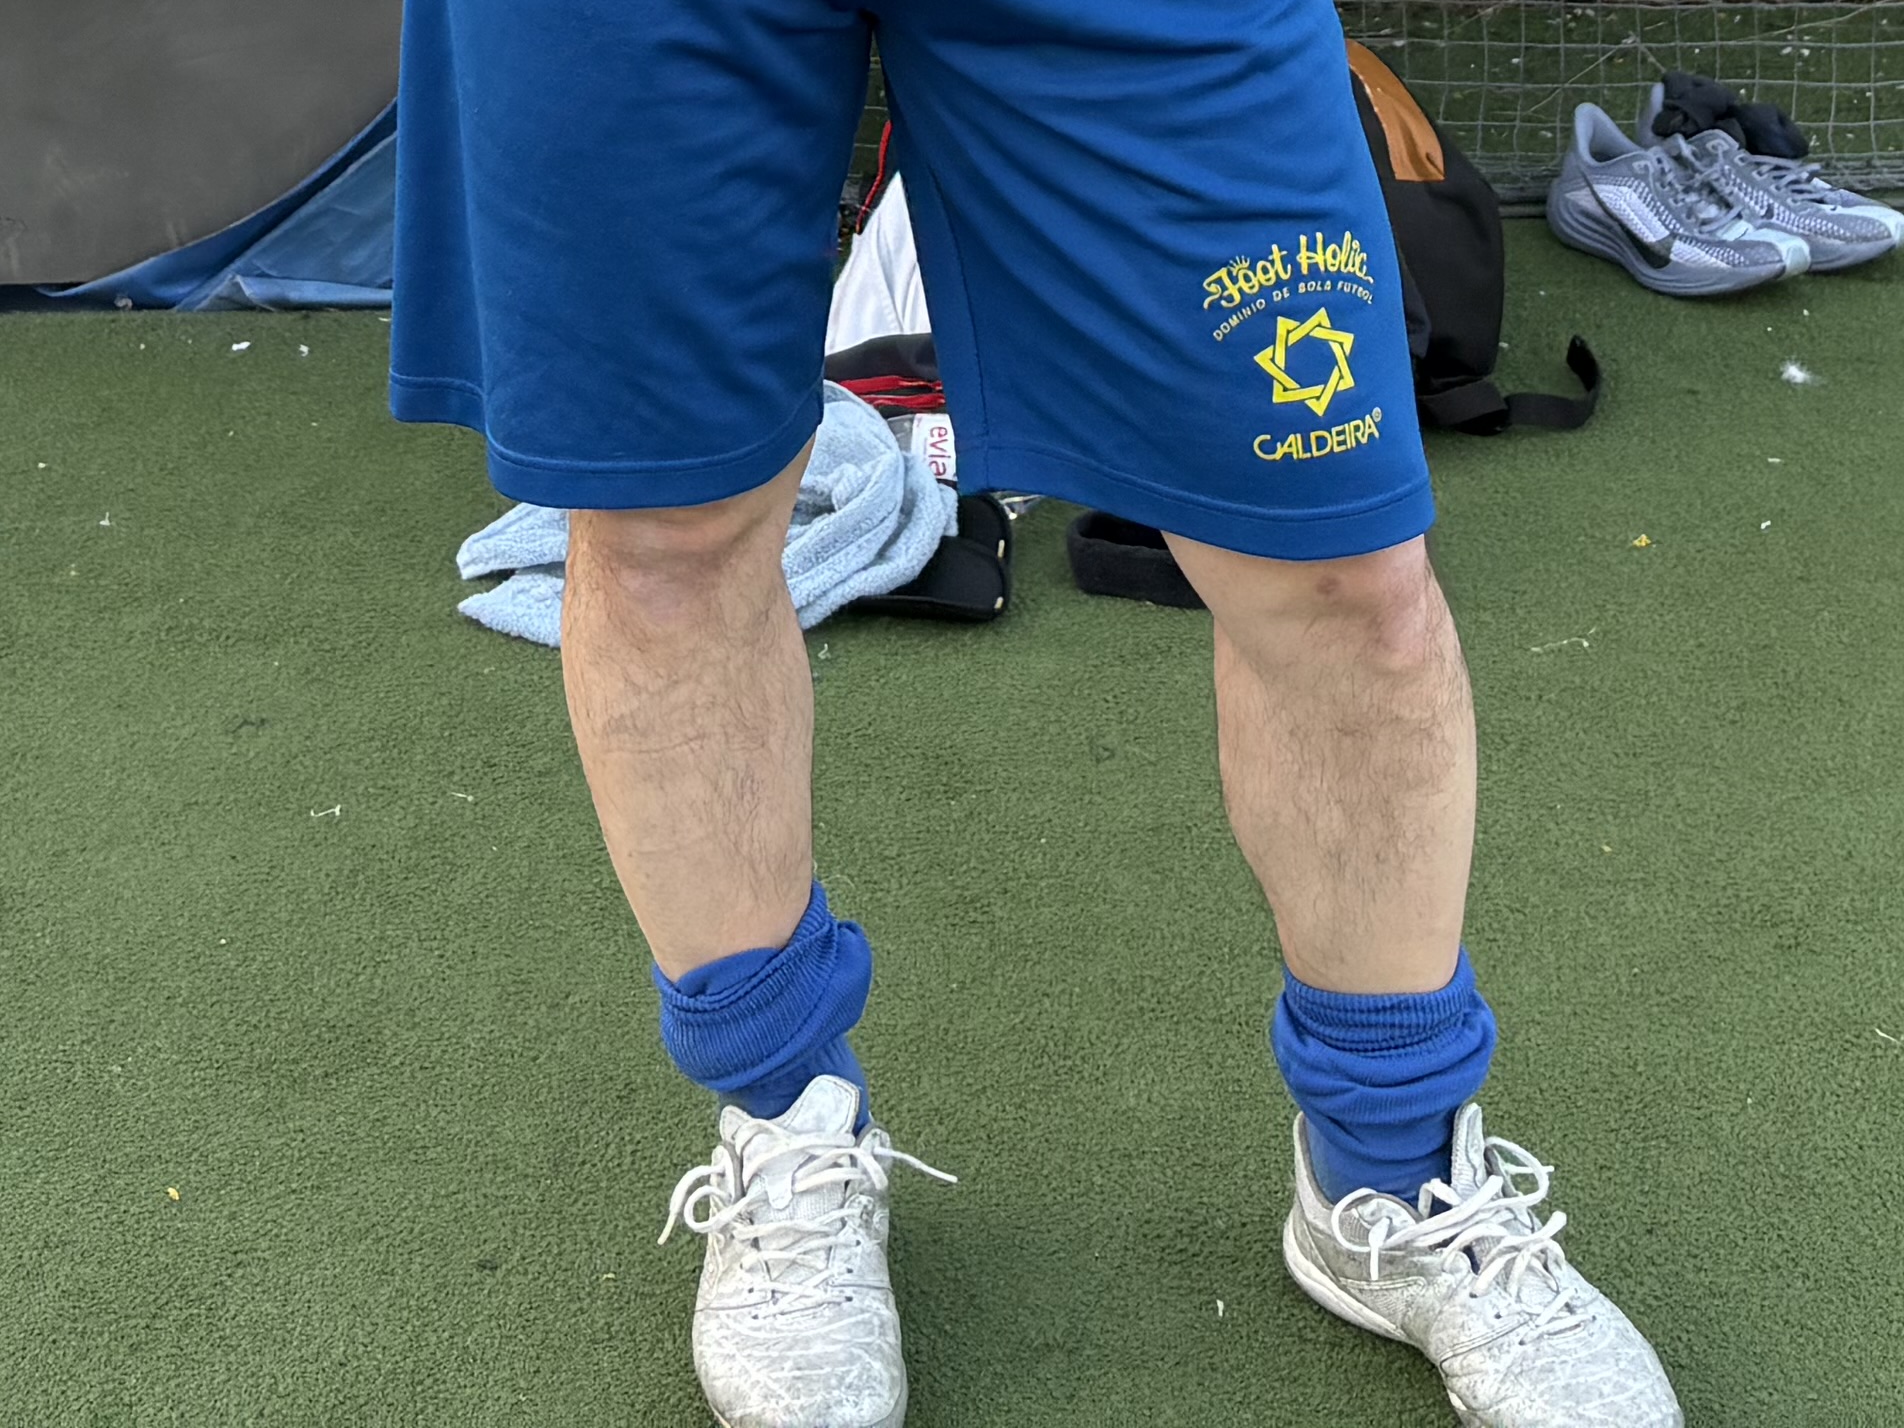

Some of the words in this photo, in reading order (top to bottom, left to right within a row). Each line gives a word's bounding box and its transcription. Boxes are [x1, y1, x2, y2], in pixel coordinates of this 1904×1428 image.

[1202, 243, 1292, 310] Foot
[1296, 230, 1374, 284] Holic
[1212, 298, 1266, 342] DOMINIO
[1272, 286, 1291, 303] DE
[928, 426, 952, 477] evia
